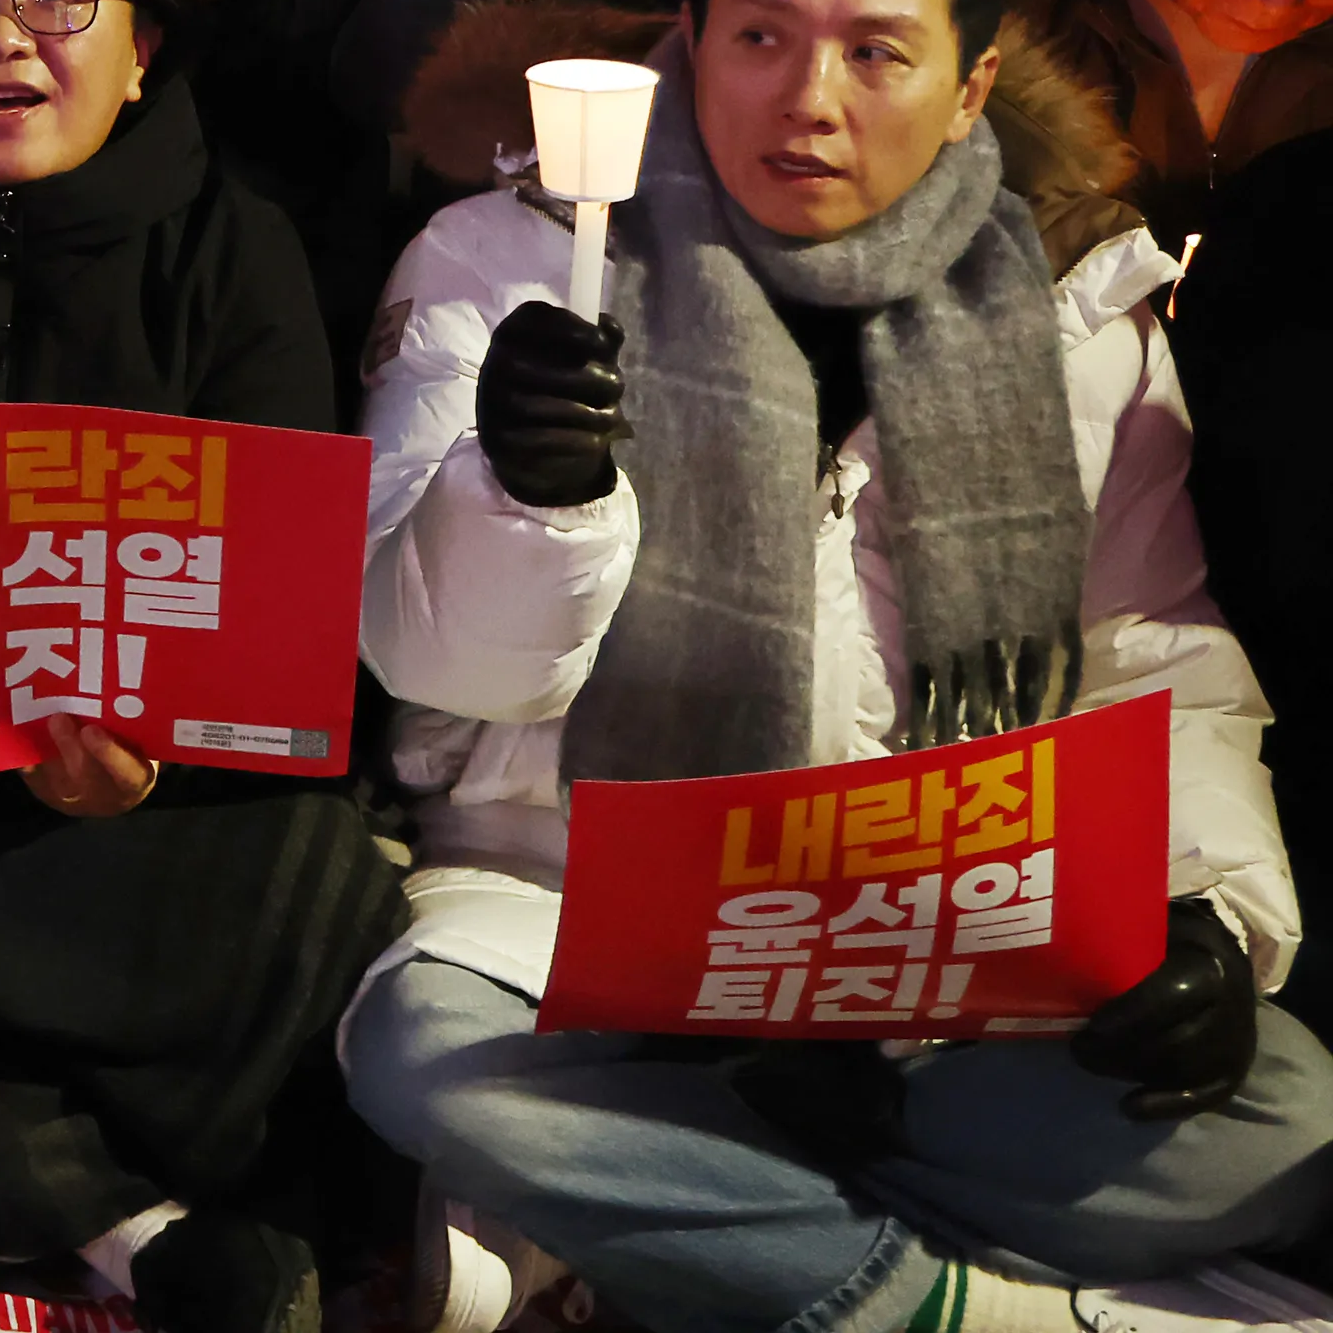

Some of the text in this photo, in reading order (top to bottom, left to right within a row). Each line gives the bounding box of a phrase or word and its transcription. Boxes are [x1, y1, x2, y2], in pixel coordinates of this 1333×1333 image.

[719, 738, 1055, 886] 내란죄
[705, 848, 1055, 966] 윤석열
[685, 962, 975, 1023] 퇴진!
